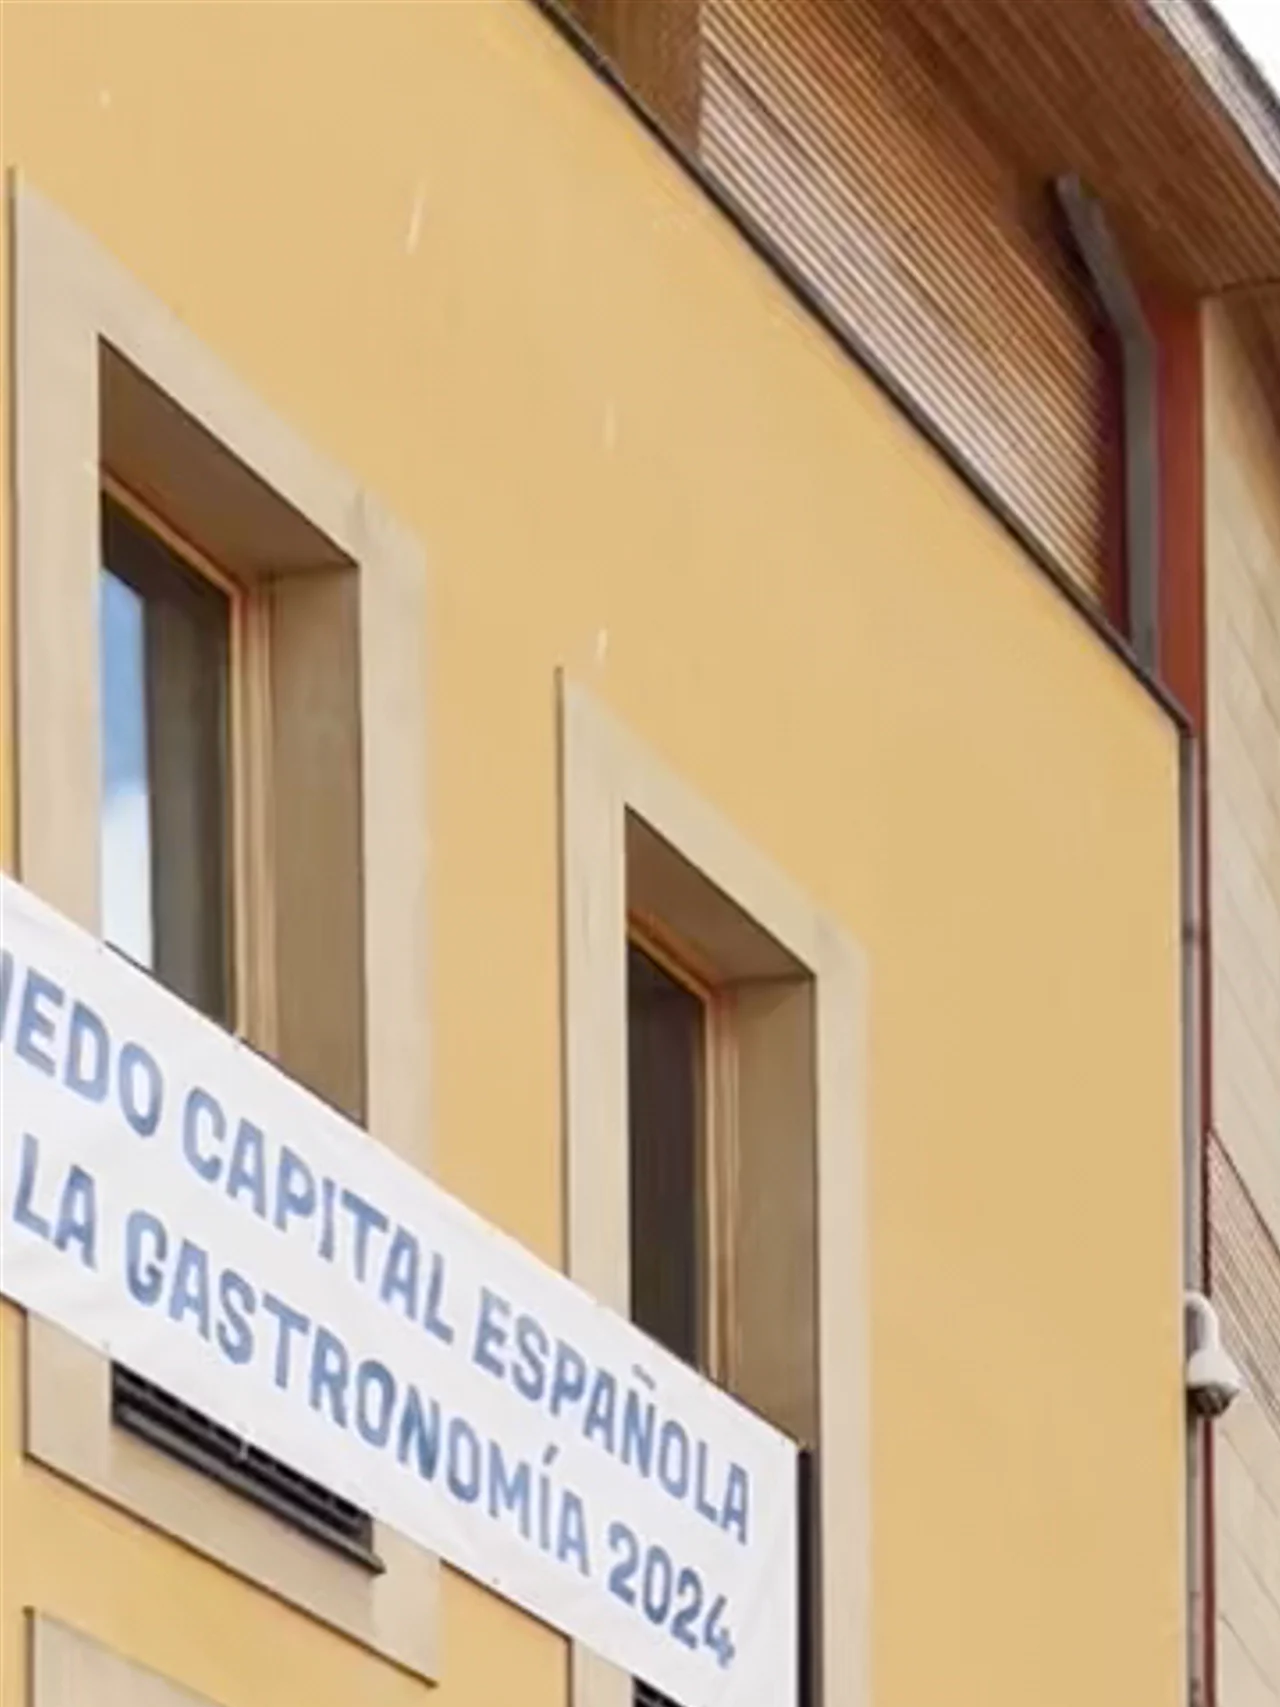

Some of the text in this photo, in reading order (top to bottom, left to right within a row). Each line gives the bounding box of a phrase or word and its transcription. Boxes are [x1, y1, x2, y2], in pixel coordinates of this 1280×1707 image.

[12, 1131, 736, 1669] LA GASTRONOMÍA 2024
[182, 1085, 455, 1346] CAPITAL
[471, 1286, 750, 1546] ESPAÑOLA
